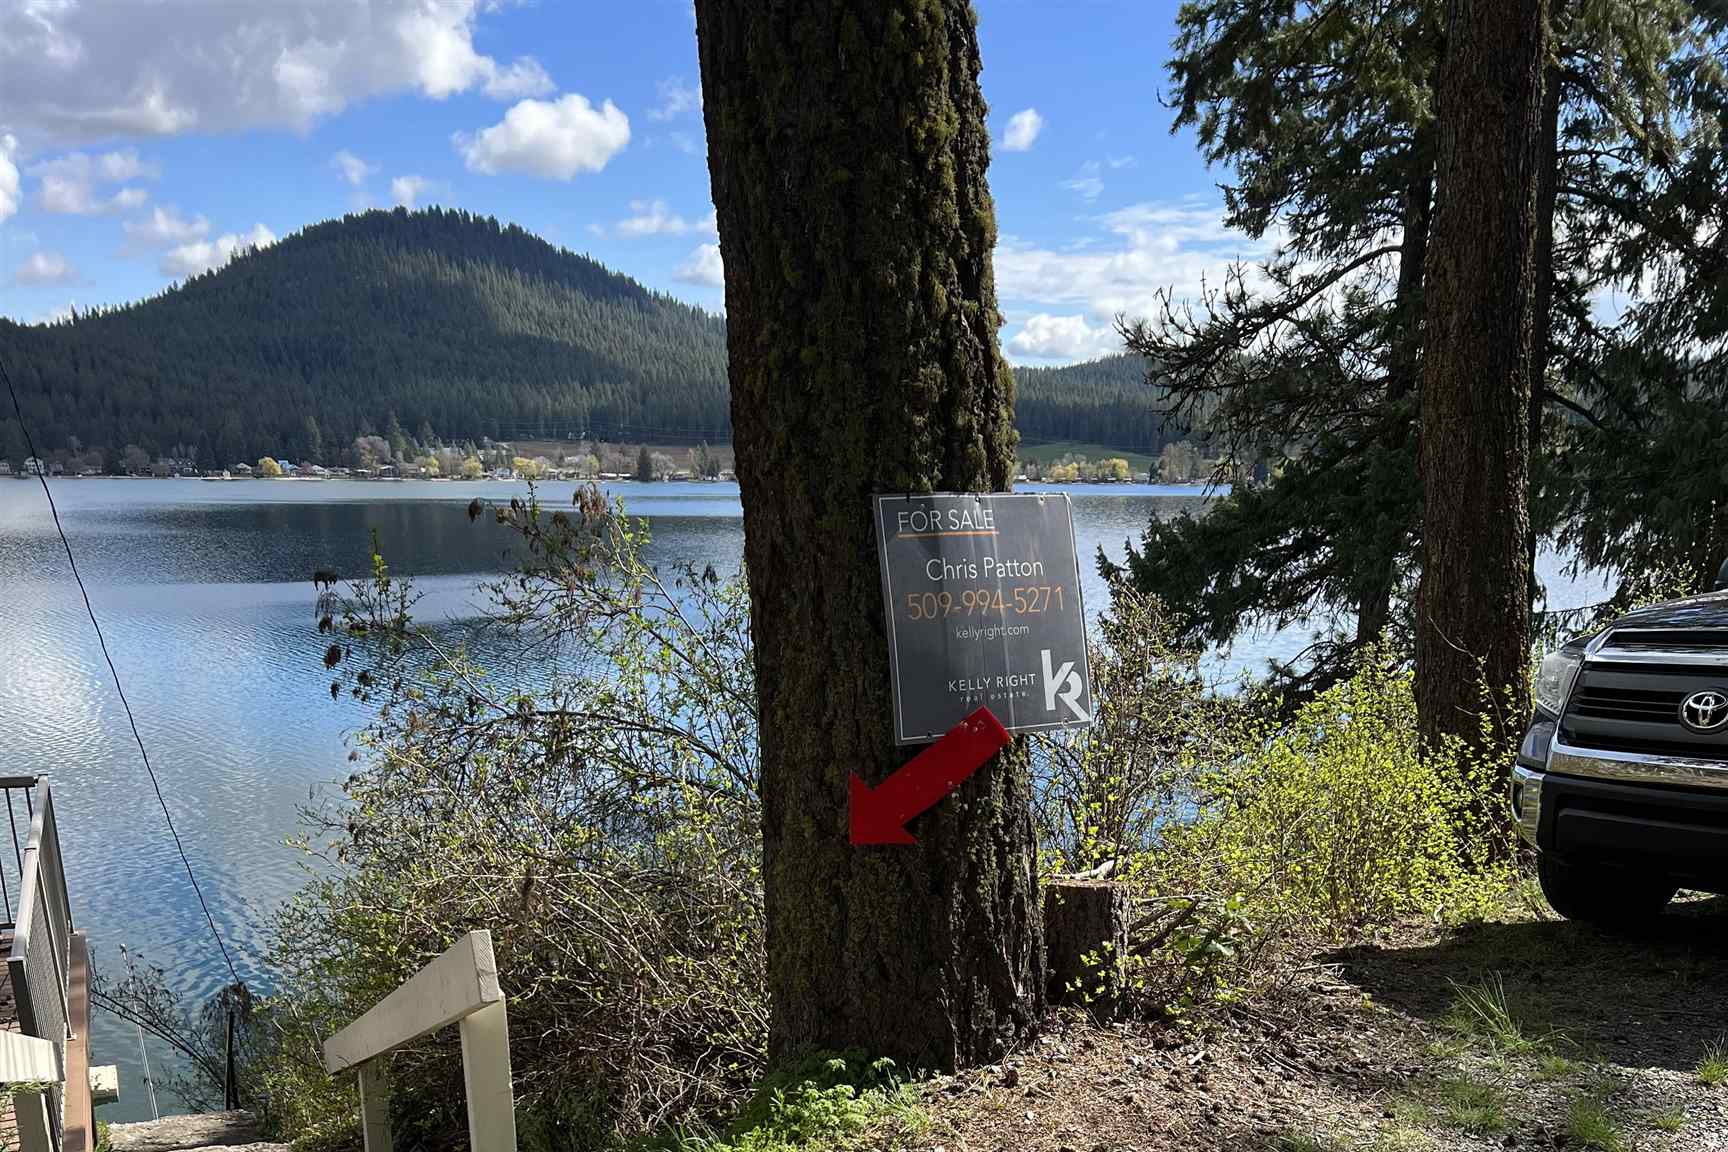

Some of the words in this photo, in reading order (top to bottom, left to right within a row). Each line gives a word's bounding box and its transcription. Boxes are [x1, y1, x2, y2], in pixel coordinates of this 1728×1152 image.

[897, 511, 943, 532] FOR
[949, 508, 995, 530] SALE
[926, 557, 978, 581] Chris
[983, 557, 1044, 579] Patton
[907, 586, 1065, 620] 509-994-5271
[956, 624, 1030, 641] kellyright.com
[948, 677, 991, 692] KELLY
[996, 673, 1036, 688] RIGHT
